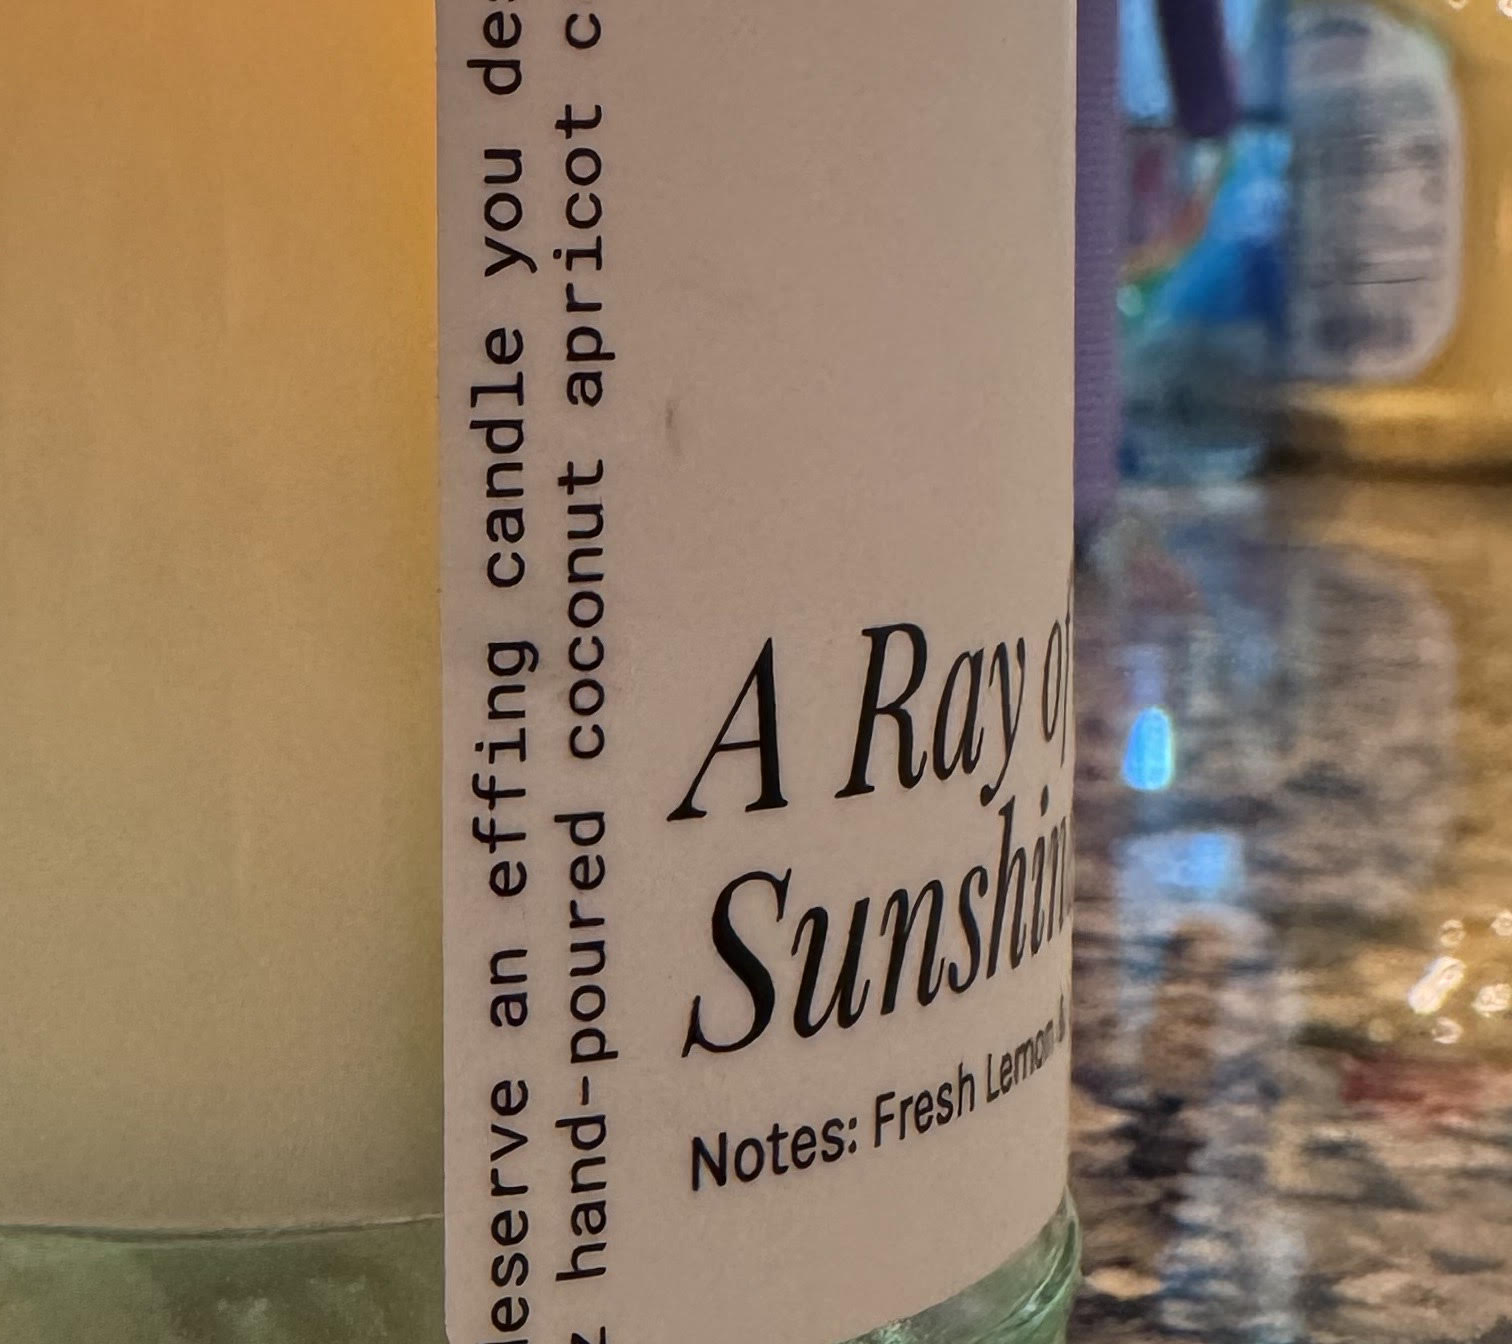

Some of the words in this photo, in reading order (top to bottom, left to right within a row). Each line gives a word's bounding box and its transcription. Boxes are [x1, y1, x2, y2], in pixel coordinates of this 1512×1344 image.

[483, 148, 539, 278] you
[552, 102, 616, 409] apricot
[469, 327, 526, 590] candle
[556, 458, 606, 761] coconut
[666, 636, 789, 824] A
[833, 622, 1026, 808] Ray
[471, 640, 541, 899] effing
[488, 948, 529, 1029] an
[553, 810, 620, 1283] hand-poured
[680, 785, 1073, 1060] Sunshin
[690, 1116, 859, 1193] Notes:
[873, 1061, 976, 1150] Fresh
[986, 1019, 1055, 1104] Lemon
